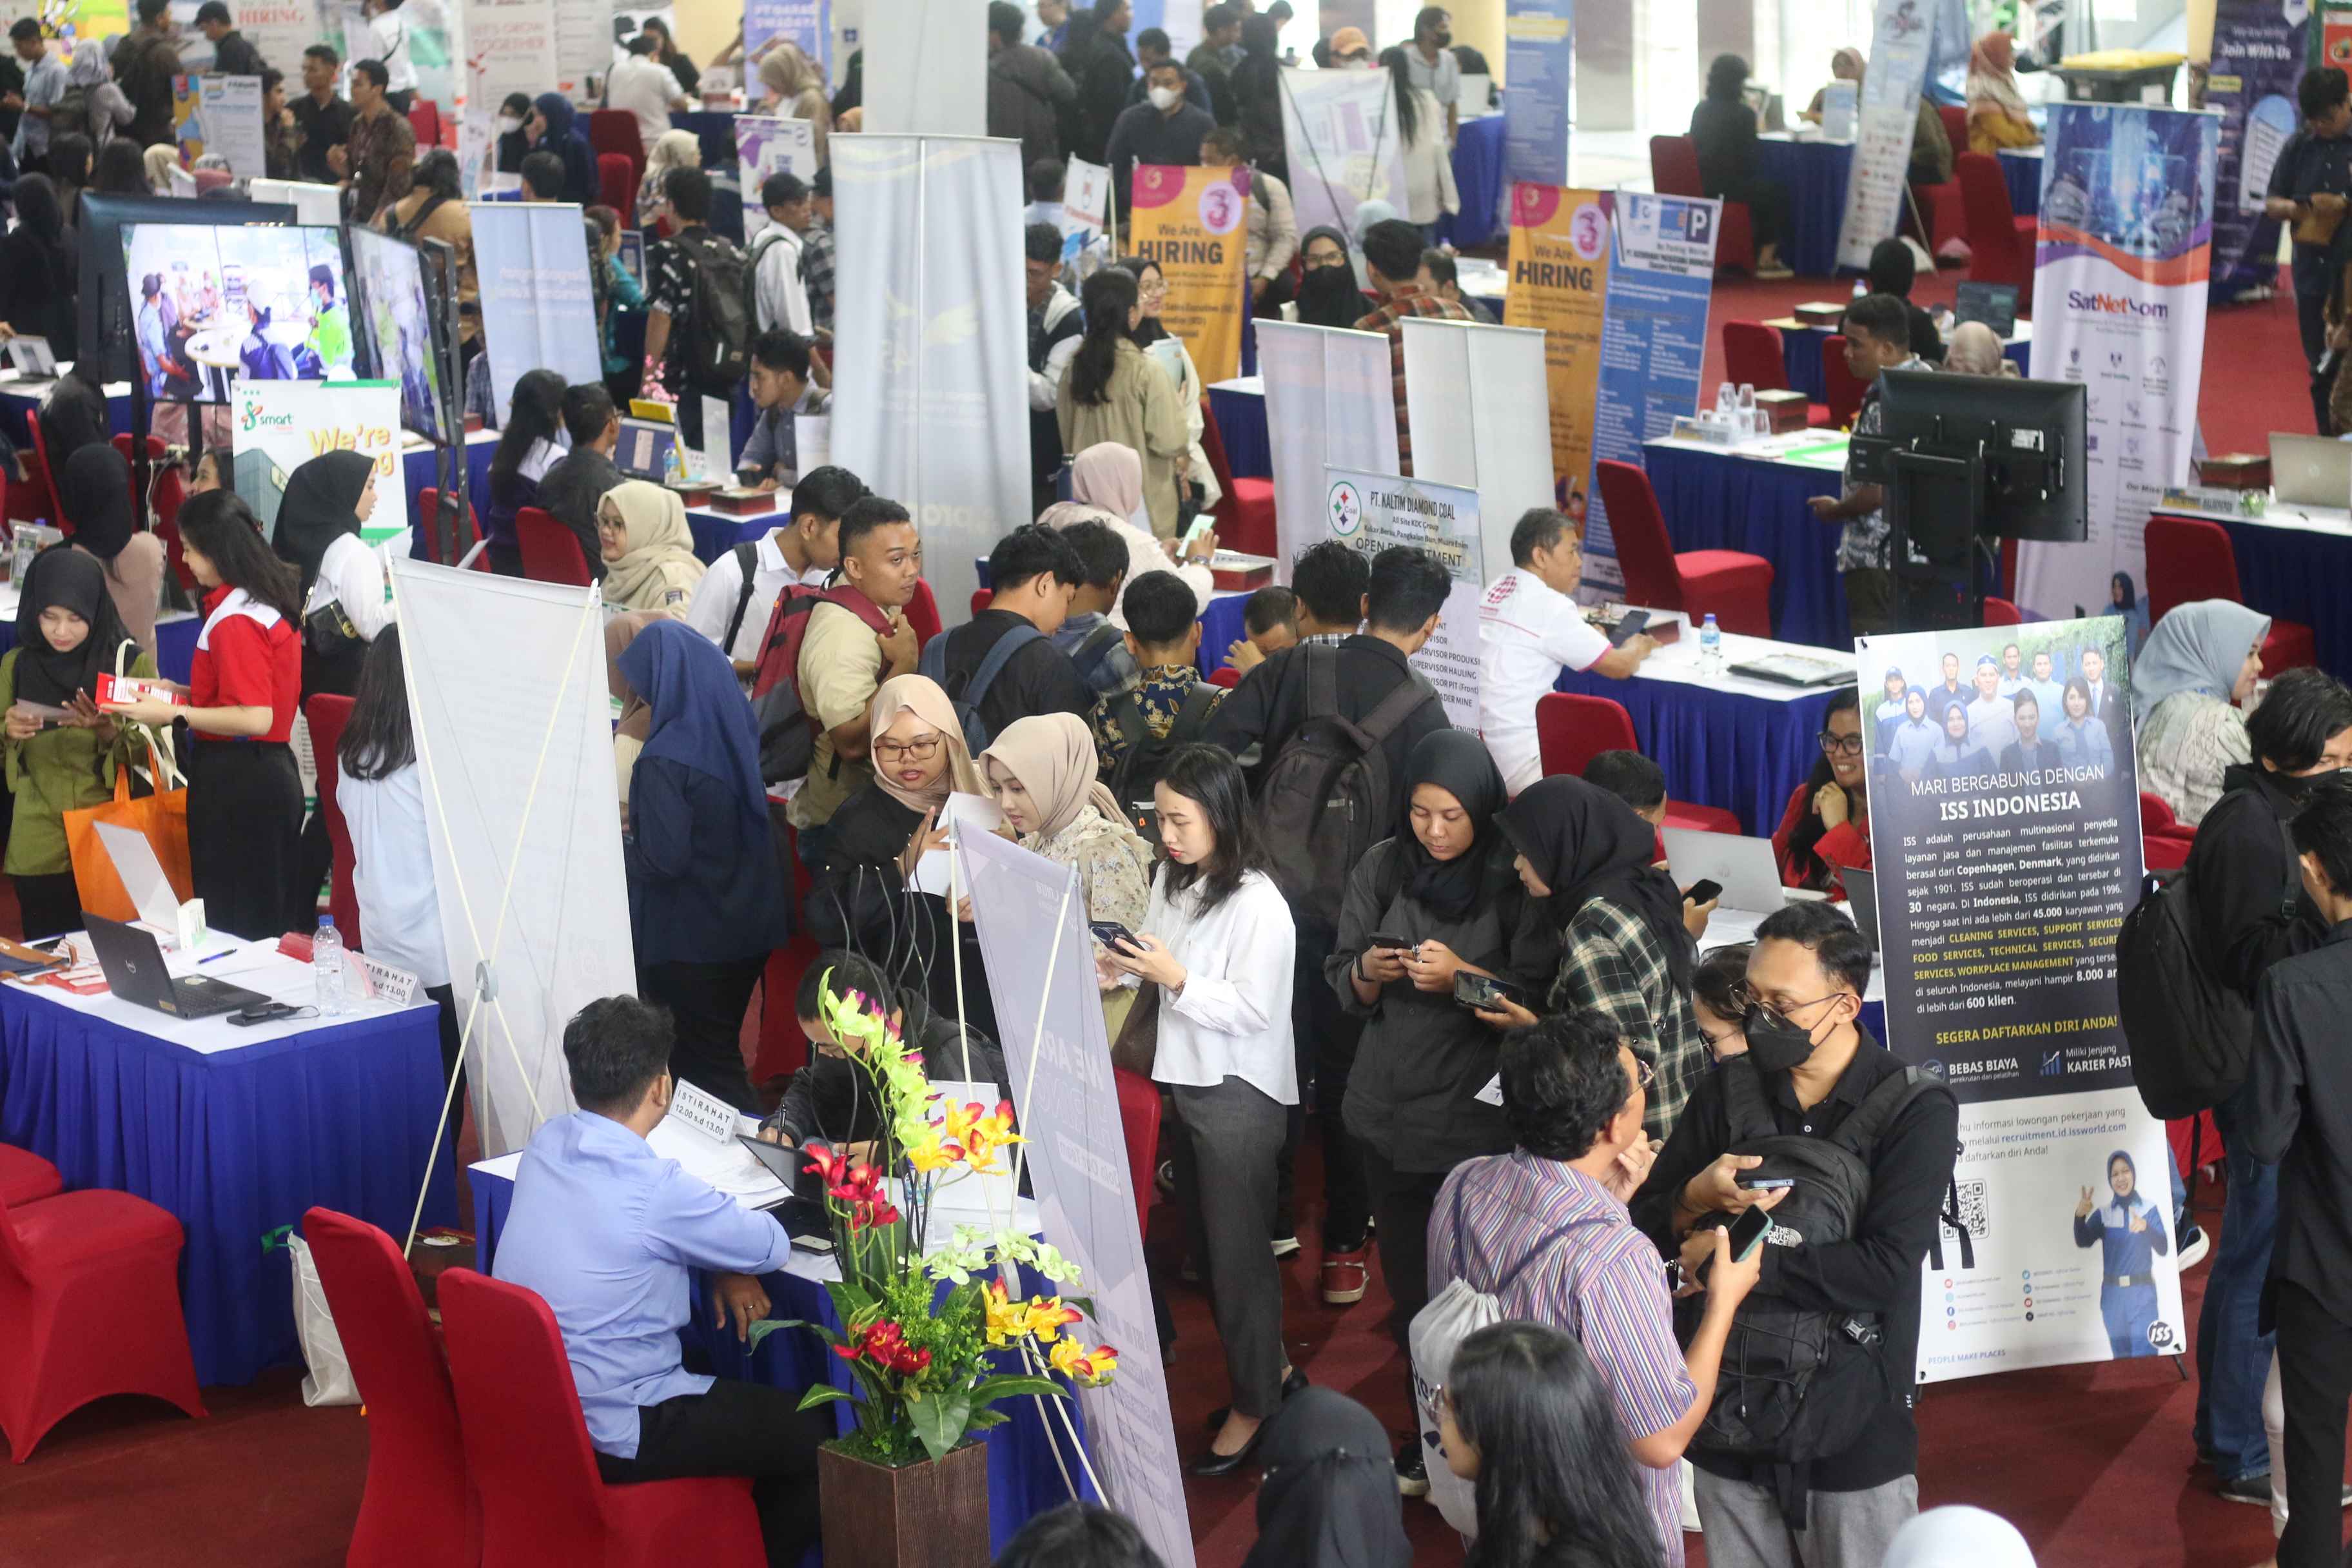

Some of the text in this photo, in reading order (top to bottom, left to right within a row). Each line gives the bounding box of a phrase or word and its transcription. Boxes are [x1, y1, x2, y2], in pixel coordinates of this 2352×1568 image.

[2222, 42, 2292, 61] Join With Us
[1157, 224, 1200, 236] We Are
[1690, 209, 1707, 237] P
[1139, 240, 1224, 264] HIRING
[1535, 246, 1572, 259] We Are
[1516, 260, 1592, 291] HIRING
[260, 413, 293, 425] smart
[307, 424, 391, 456] We're
[1344, 505, 1357, 514] Coal
[1371, 491, 1455, 520] PT. KALTIM DIAMOND COAL
[1400, 518, 1410, 526] Site
[1411, 520, 1422, 528] KDC
[1423, 522, 1439, 533] Group
[1356, 537, 1384, 553] OPEN
[1449, 652, 1480, 665] PRODUKSI
[1449, 667, 1476, 679] HAULING
[1449, 681, 1478, 694] PIT (Front)
[1456, 697, 1473, 707] MINE
[1911, 763, 2104, 796] MARI BERGABUNG DENGAN
[1940, 790, 2081, 821] ISS INDONESIA
[1903, 817, 2118, 846] ISS adalah perusahaan multinasional penyedia
[1905, 834, 2119, 865] layanan jasa dan manajemen fasilitas terkemuka
[1906, 852, 2120, 879] berasal dari Copenhagen, Denmark, yang didirikan
[1908, 870, 2110, 898] sejak 1901. ISS sudah beroperasi dan tersebar
[1908, 883, 2122, 914] 30 negara. Indonesia, ISS didirikan pada 1996.
[1910, 902, 2123, 932] Hingga saat ada lebih dari 45.000 karyawan yang
[1912, 917, 2122, 948] menjadi CLEANING SERVICES, SUPPORT SERVICES
[1913, 953, 1938, 963] FOOD
[1943, 948, 1985, 961] SERVICES,
[1989, 944, 2038, 956] TECHNICAL
[2043, 939, 2084, 951] SERVICES,
[1914, 956, 2095, 980] SERVICES, WORKPLACE MANAGEMENT yang
[386, 985, 405, 997] 13.00
[1926, 968, 2103, 995] seluruh Indonesia, melayani hampir 8.000
[1926, 994, 2016, 1013] lebih dari 600 klien.
[1936, 1015, 2117, 1045] SEGERA DAFTARKAN DIRI ANDA!
[2065, 1044, 2117, 1058] Miliki Jenjang
[1949, 1057, 2018, 1075] BEBAS BIAYA
[2067, 1055, 2132, 1073] KARIER PAST
[1949, 1075, 1981, 1085] perekrutan
[1993, 1072, 2019, 1081] pelatihan
[678, 1090, 730, 1123] ISTIRAHAT
[676, 1104, 724, 1136] 12.00 s.d 13.00
[1974, 1108, 2126, 1130] informasi lowongan pekerjaan yang
[1969, 1123, 2126, 1146] melalui recruitment.id.issworld.com
[1966, 1145, 2048, 1162] daftarkan diri Anda!
[1765, 1230, 1789, 1240] ORTH
[1774, 1225, 1790, 1234] THE
[1768, 1237, 1788, 1246] FACE
[1928, 1349, 2006, 1364] PEOPLE MAKE PLACES
